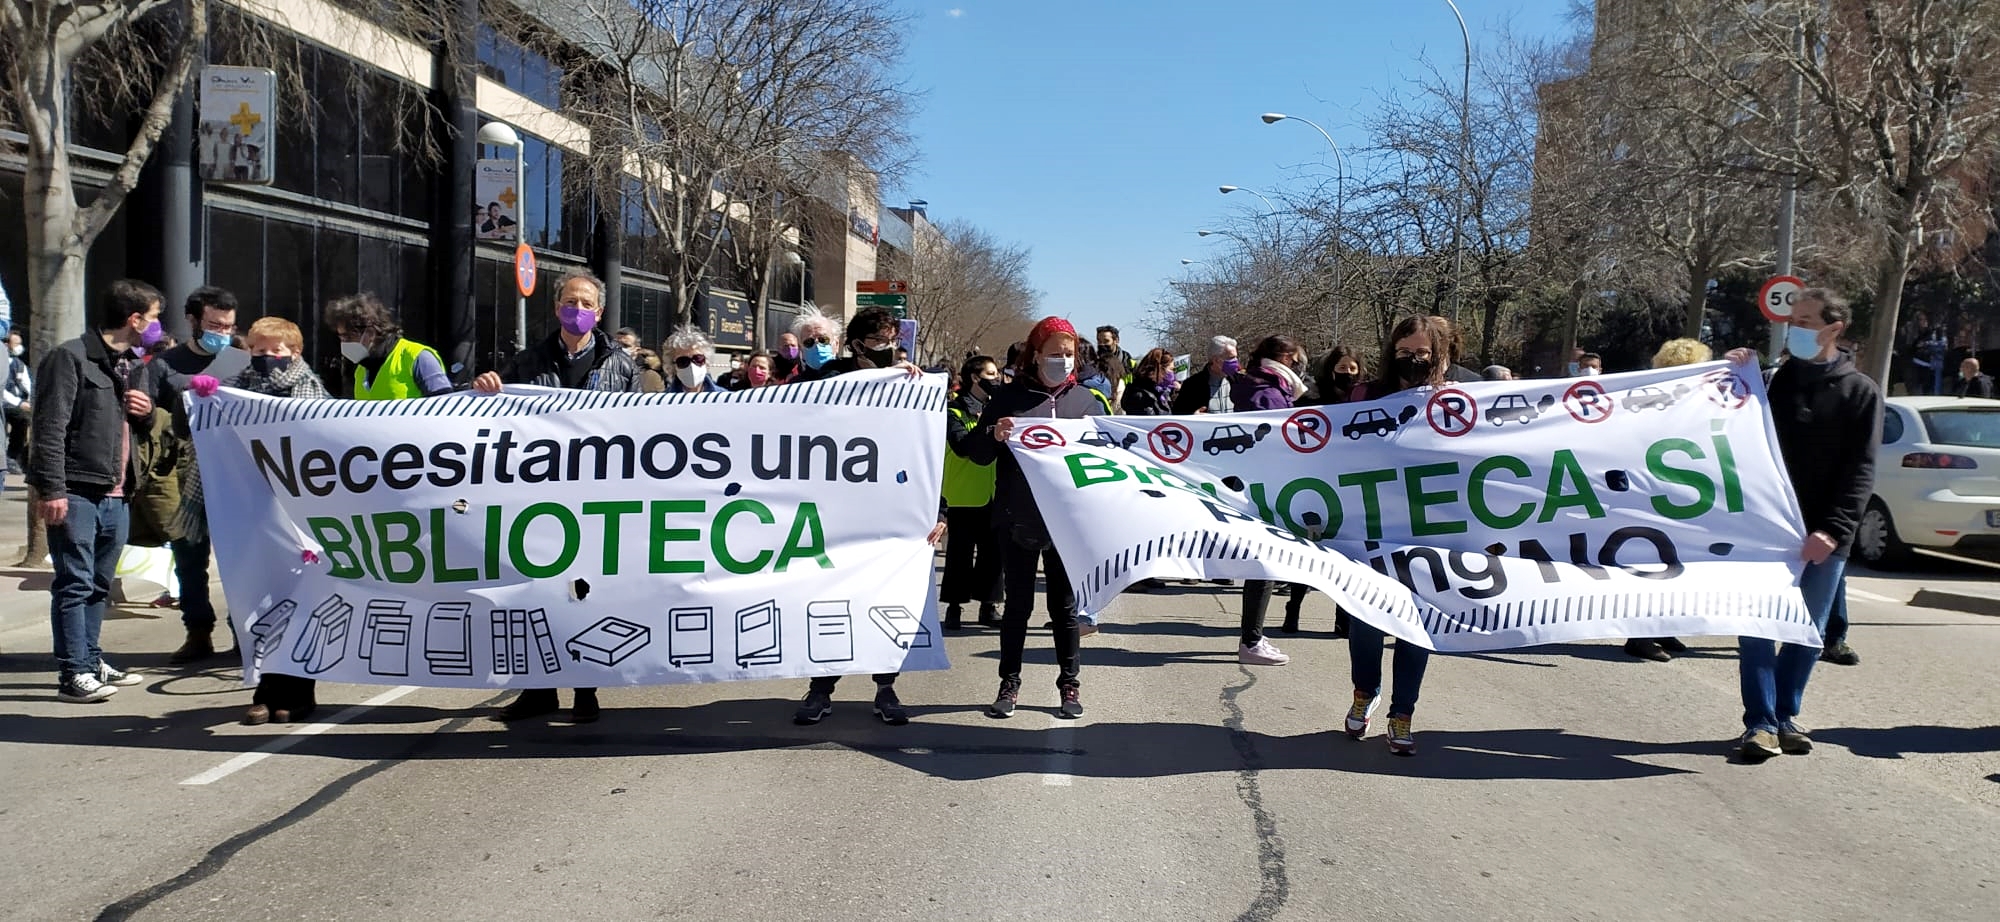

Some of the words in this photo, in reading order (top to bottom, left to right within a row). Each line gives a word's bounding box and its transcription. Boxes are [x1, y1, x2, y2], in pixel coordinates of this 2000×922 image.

[1770, 291, 1795, 306] 50
[251, 429, 732, 497] Necesitamos
[751, 433, 879, 483] una
[1645, 418, 1745, 520] SÍ
[307, 499, 835, 583] BIBLIOTECA
[1519, 526, 1685, 583] NO
